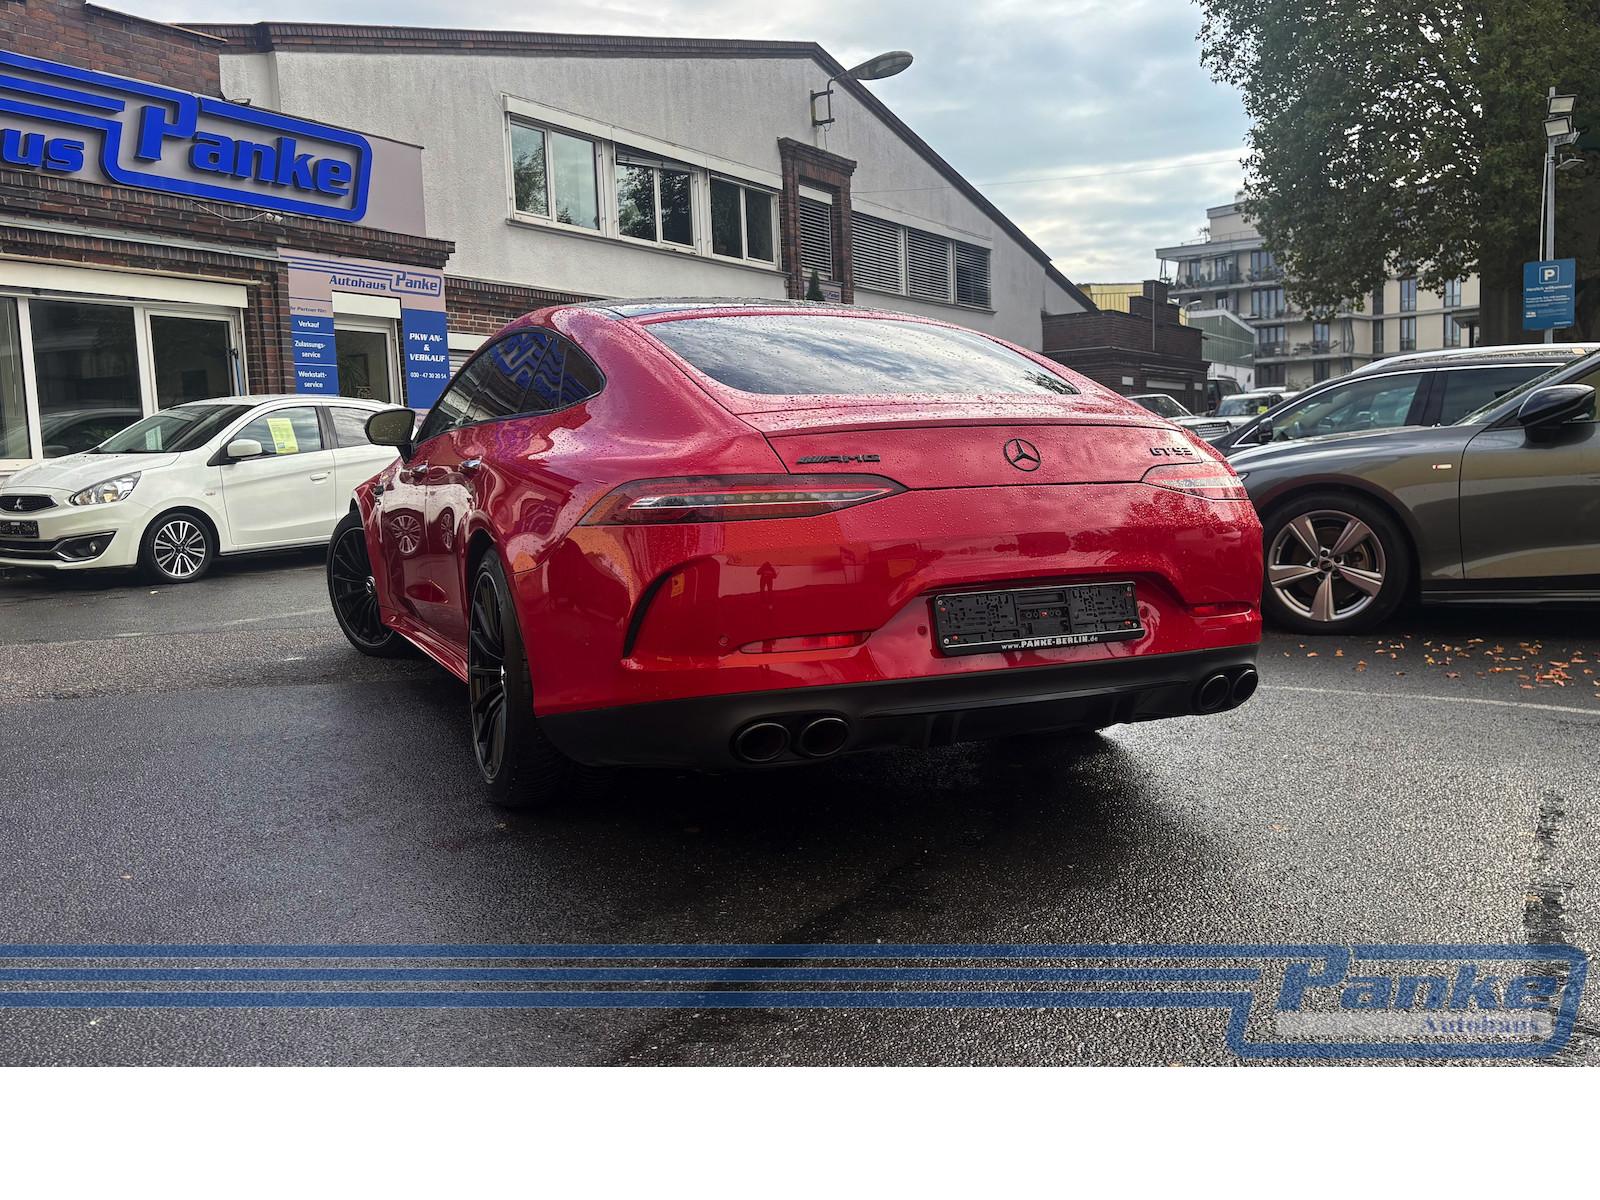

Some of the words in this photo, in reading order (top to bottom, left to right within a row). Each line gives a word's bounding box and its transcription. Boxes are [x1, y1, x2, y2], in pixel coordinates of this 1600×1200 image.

[133, 95, 352, 196] Panke
[1544, 269, 1555, 281] P
[329, 274, 387, 290] Autohaus
[395, 271, 438, 291] Panke
[298, 320, 320, 328] Verkauf
[409, 332, 428, 341] PKW
[429, 334, 443, 342] AN-
[294, 340, 326, 350] Zulassungs-
[423, 344, 431, 352] &
[301, 351, 320, 359] service
[409, 353, 446, 362] VERKAUF
[298, 370, 328, 379] Werkstatt-
[303, 380, 323, 389] service
[797, 454, 880, 464] AMG
[1001, 635, 1099, 650] www.PANKE-BERLIN.de
